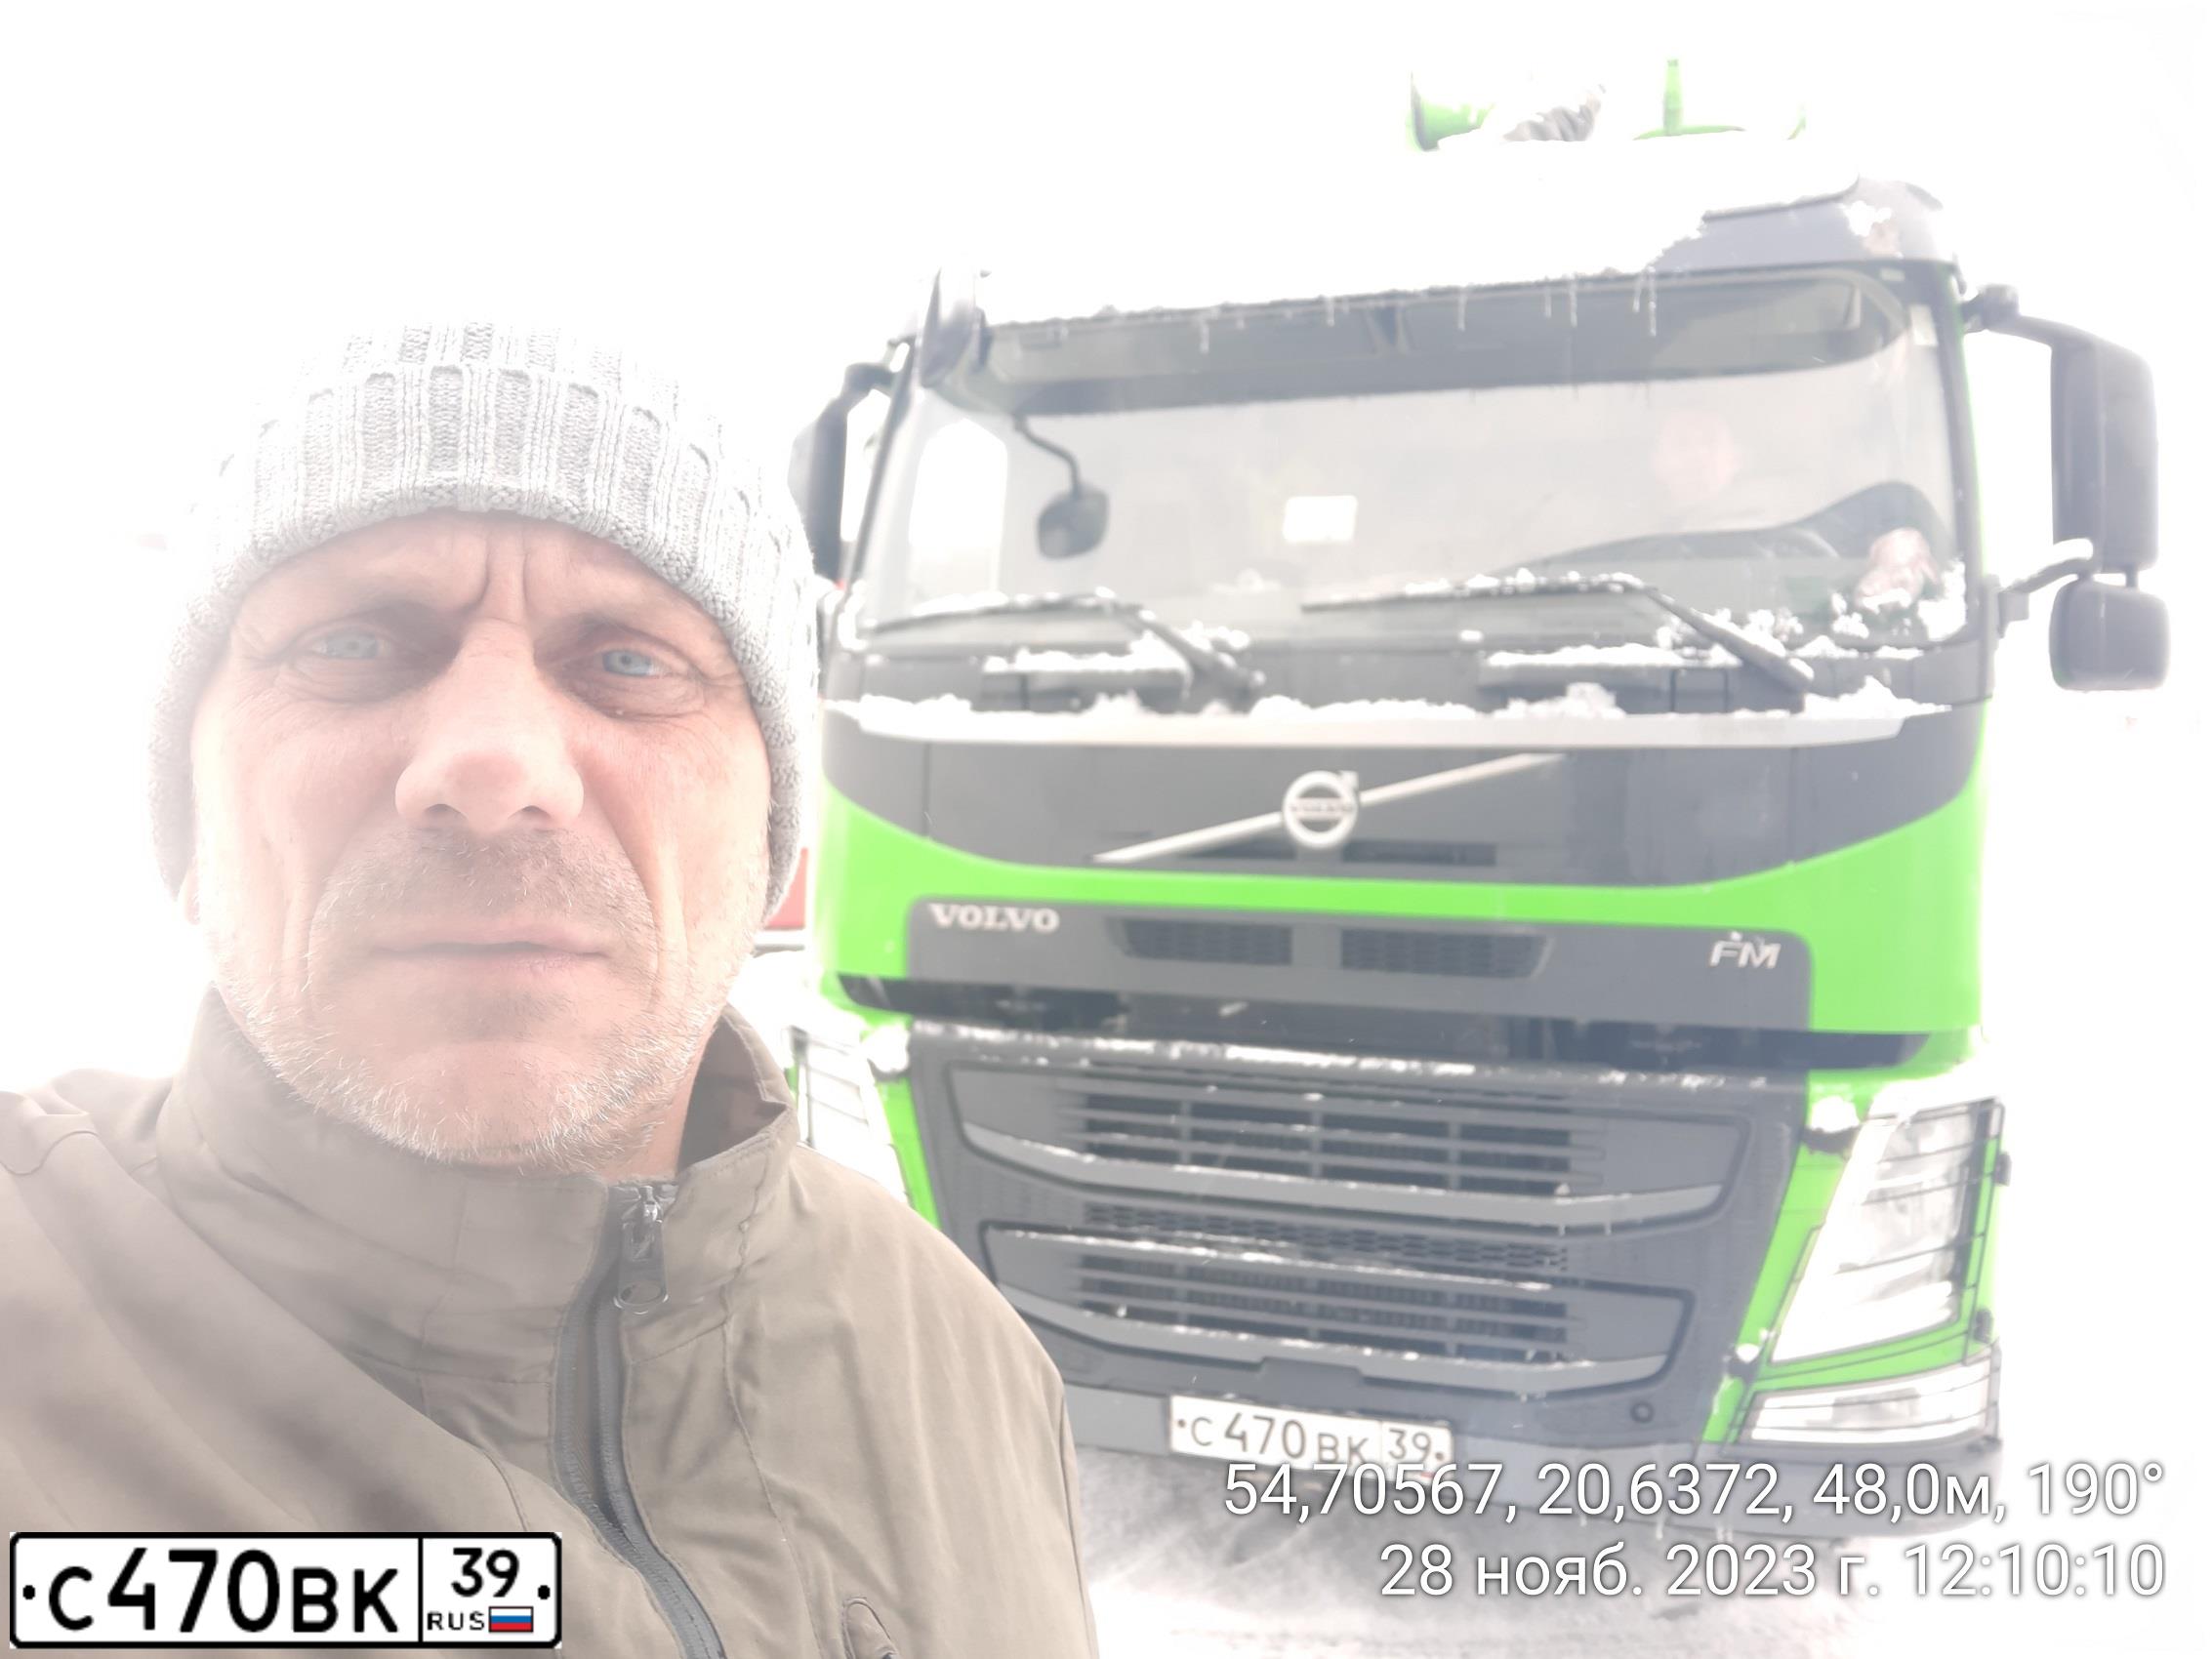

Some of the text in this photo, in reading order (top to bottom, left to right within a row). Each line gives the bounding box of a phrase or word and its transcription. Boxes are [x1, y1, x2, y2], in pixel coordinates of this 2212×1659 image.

[928, 902, 1060, 934] VOLVO
[1709, 940, 1782, 969] FM
[1387, 1428, 1432, 1463] 39
